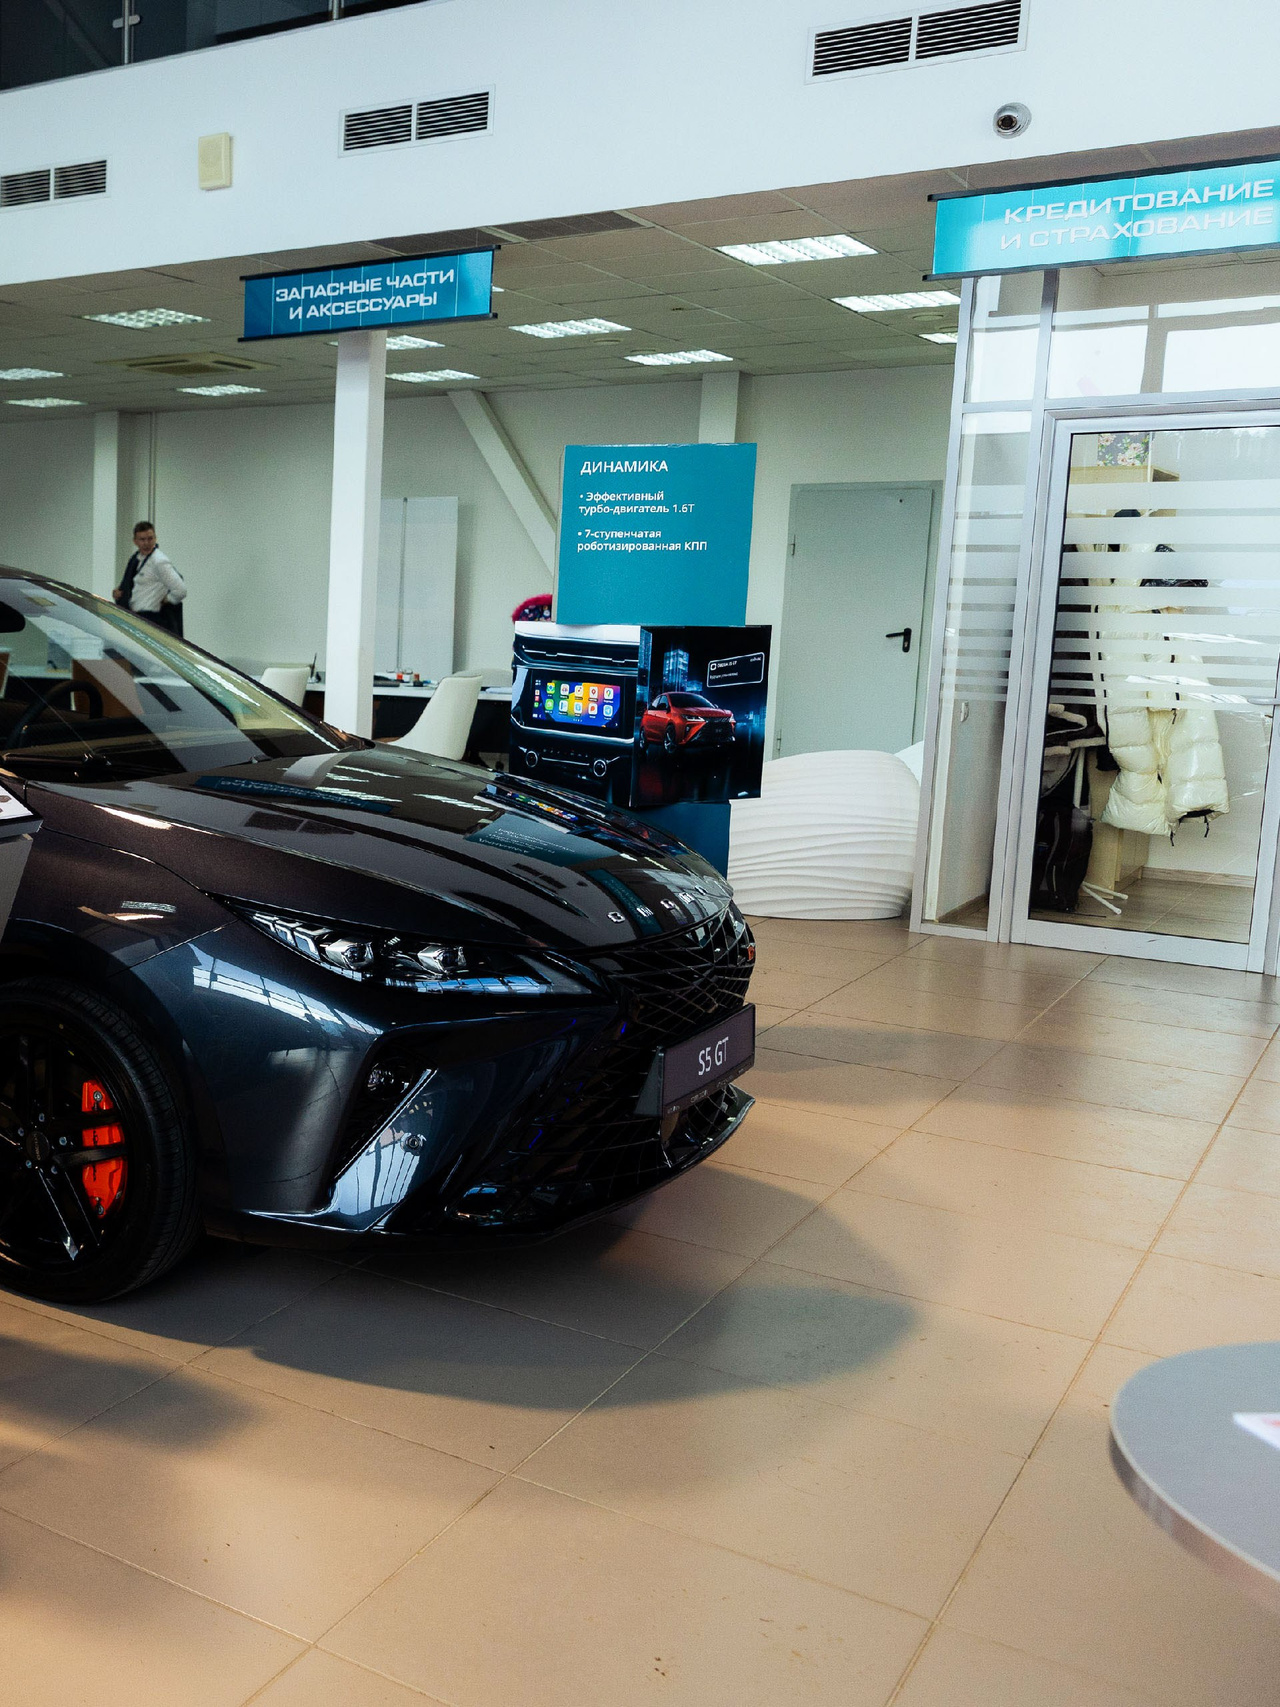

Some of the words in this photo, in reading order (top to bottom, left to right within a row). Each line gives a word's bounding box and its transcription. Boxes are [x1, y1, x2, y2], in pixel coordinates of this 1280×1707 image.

[1004, 178, 1275, 225] КРЕДИТОВАНИЕ
[1000, 233, 1022, 251] И
[1028, 206, 1274, 248] СТРАХОВАНИЕ
[275, 278, 382, 302] ЗАПАСНЫЕ
[385, 268, 455, 290] ЧАСТИ
[289, 307, 303, 320] И
[306, 291, 438, 319] АКСЕССУАРЫ
[580, 460, 669, 476] ДИНАМИКА
[586, 491, 664, 503] Эффективный
[578, 503, 670, 516] турбо-двигатель
[584, 529, 662, 540] 7-ступенчатая
[577, 541, 681, 553] роботизированная
[684, 541, 708, 551] КПП
[698, 1047, 711, 1076] S5
[714, 1036, 729, 1066] GT
